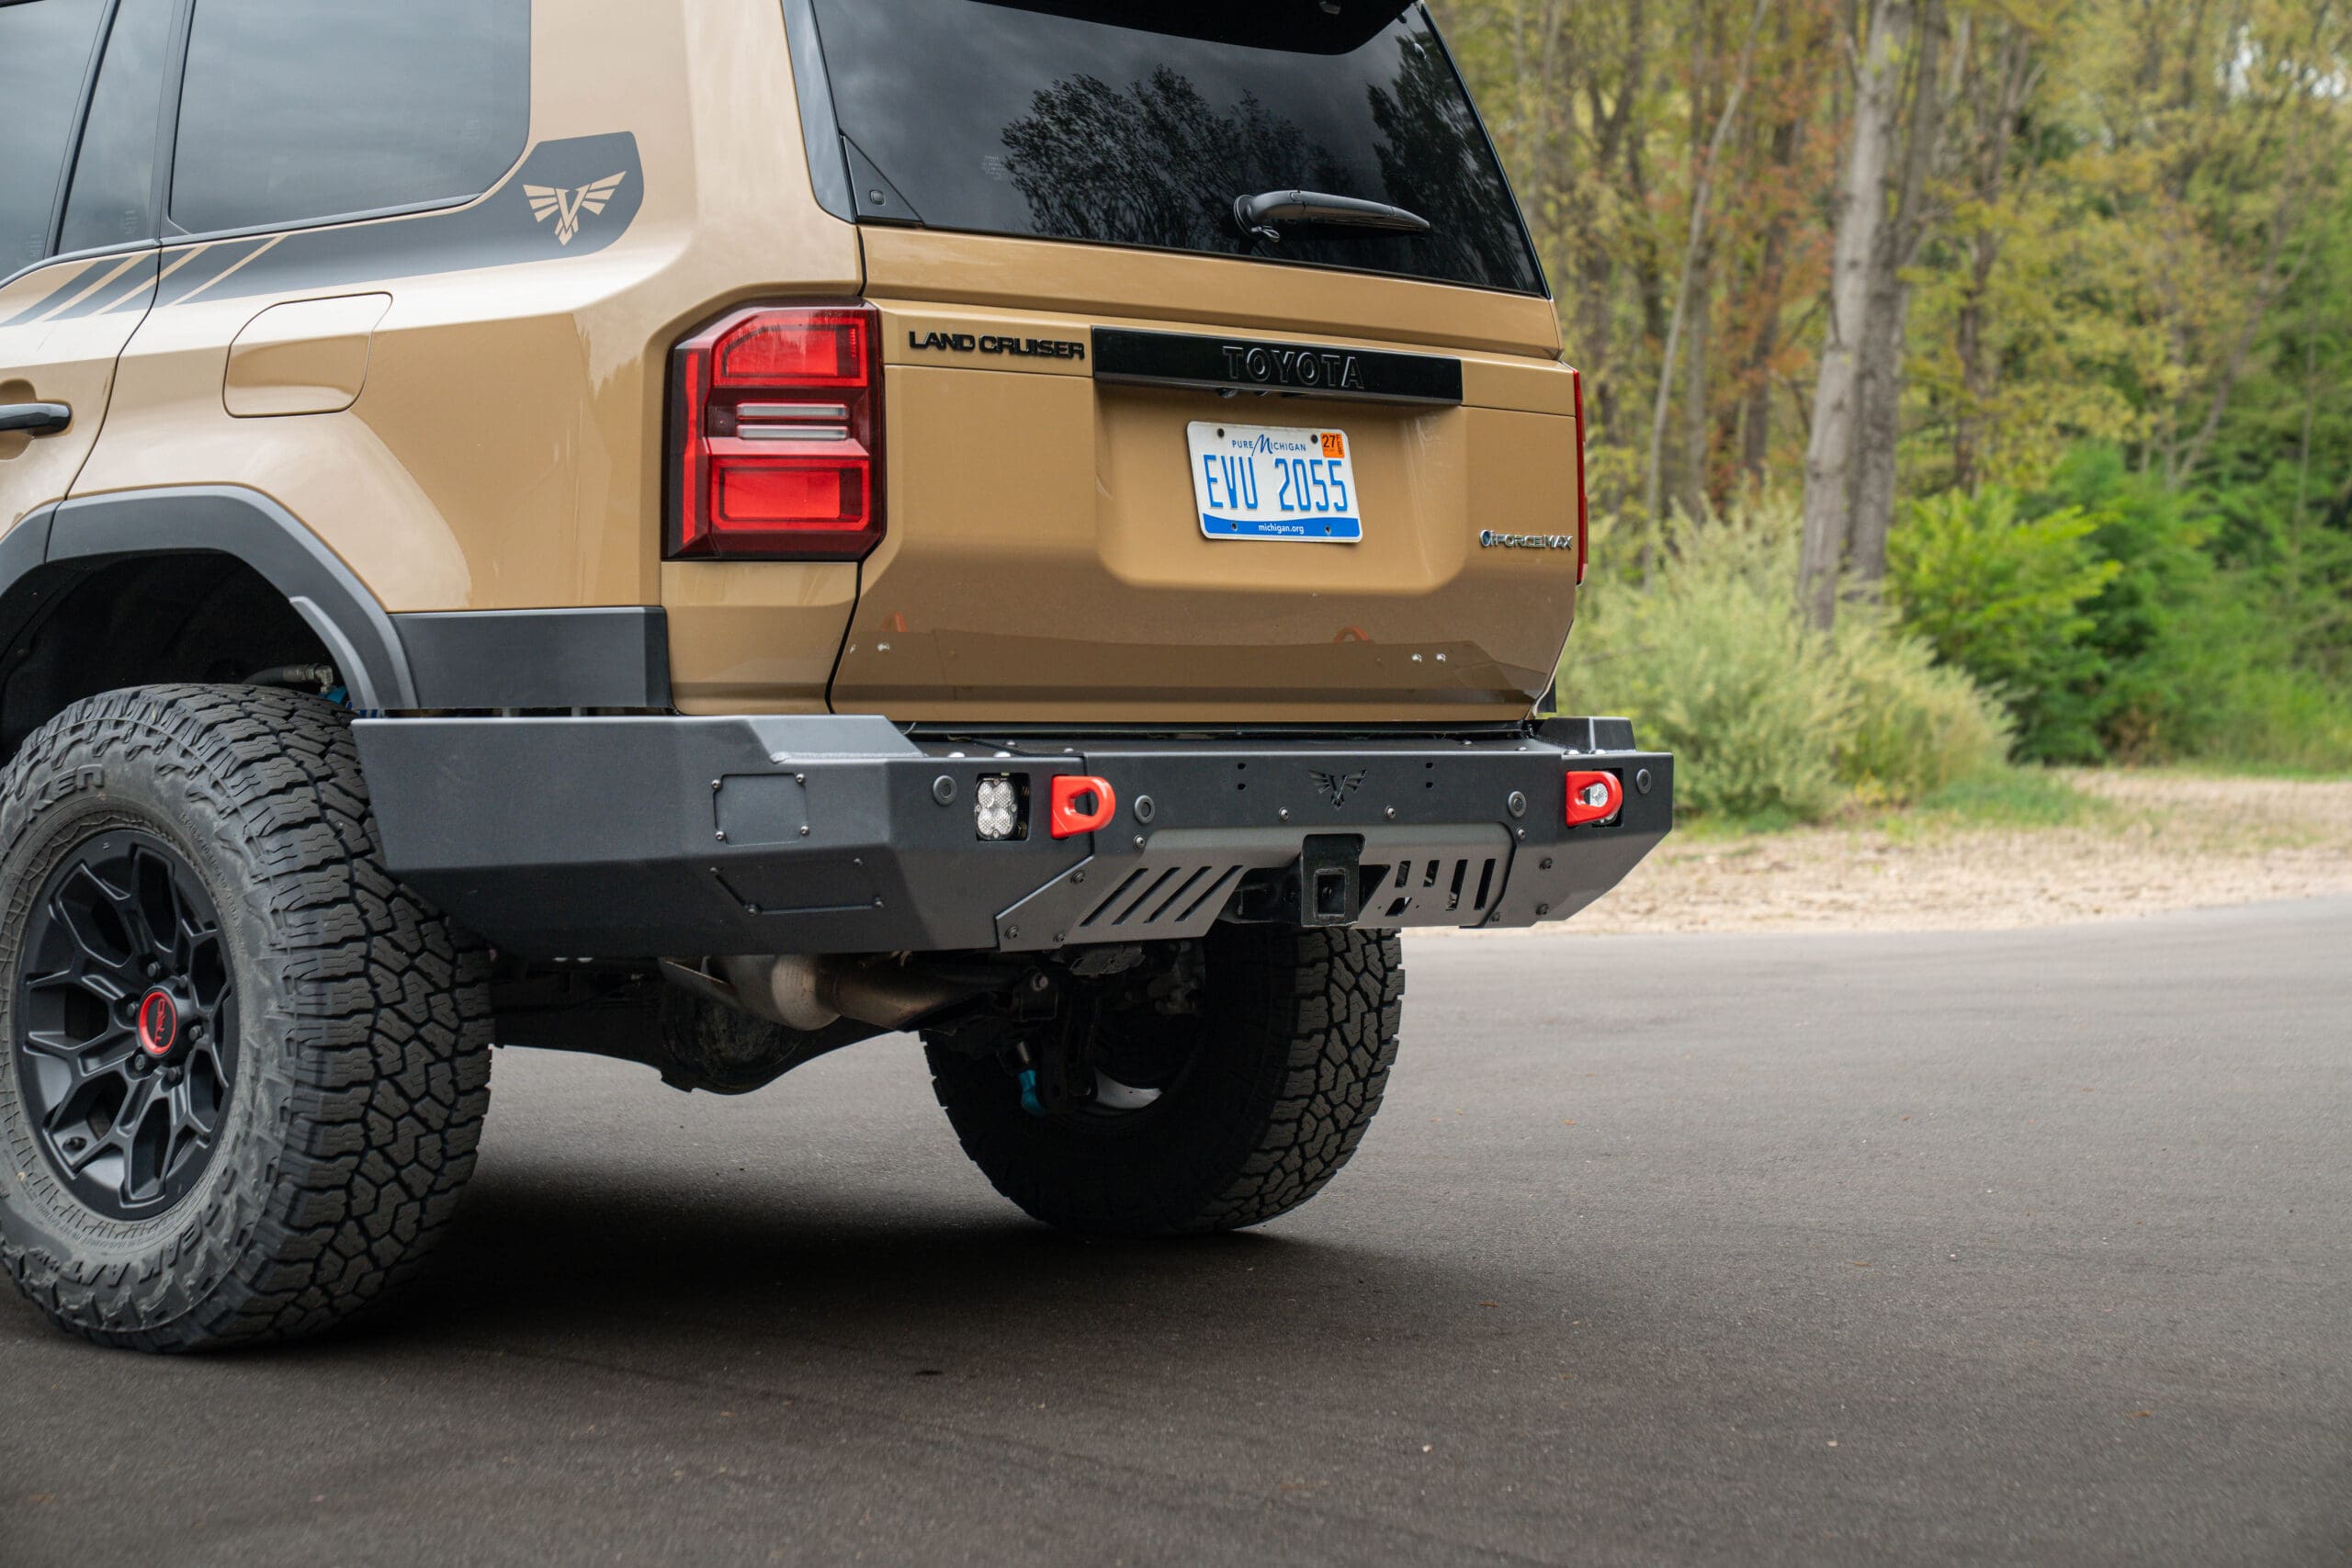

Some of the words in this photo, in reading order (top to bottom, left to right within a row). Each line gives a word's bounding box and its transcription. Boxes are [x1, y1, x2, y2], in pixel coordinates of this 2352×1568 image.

[909, 331, 976, 351] LAND
[978, 334, 1085, 360] CRUISER
[1222, 345, 1365, 389] TOYOTA
[1231, 439, 1253, 449] PURE
[1322, 434, 1336, 448] 27
[1203, 454, 1259, 510] EVU
[1274, 457, 1348, 512] 2055
[1258, 523, 1305, 535] michigan.org
